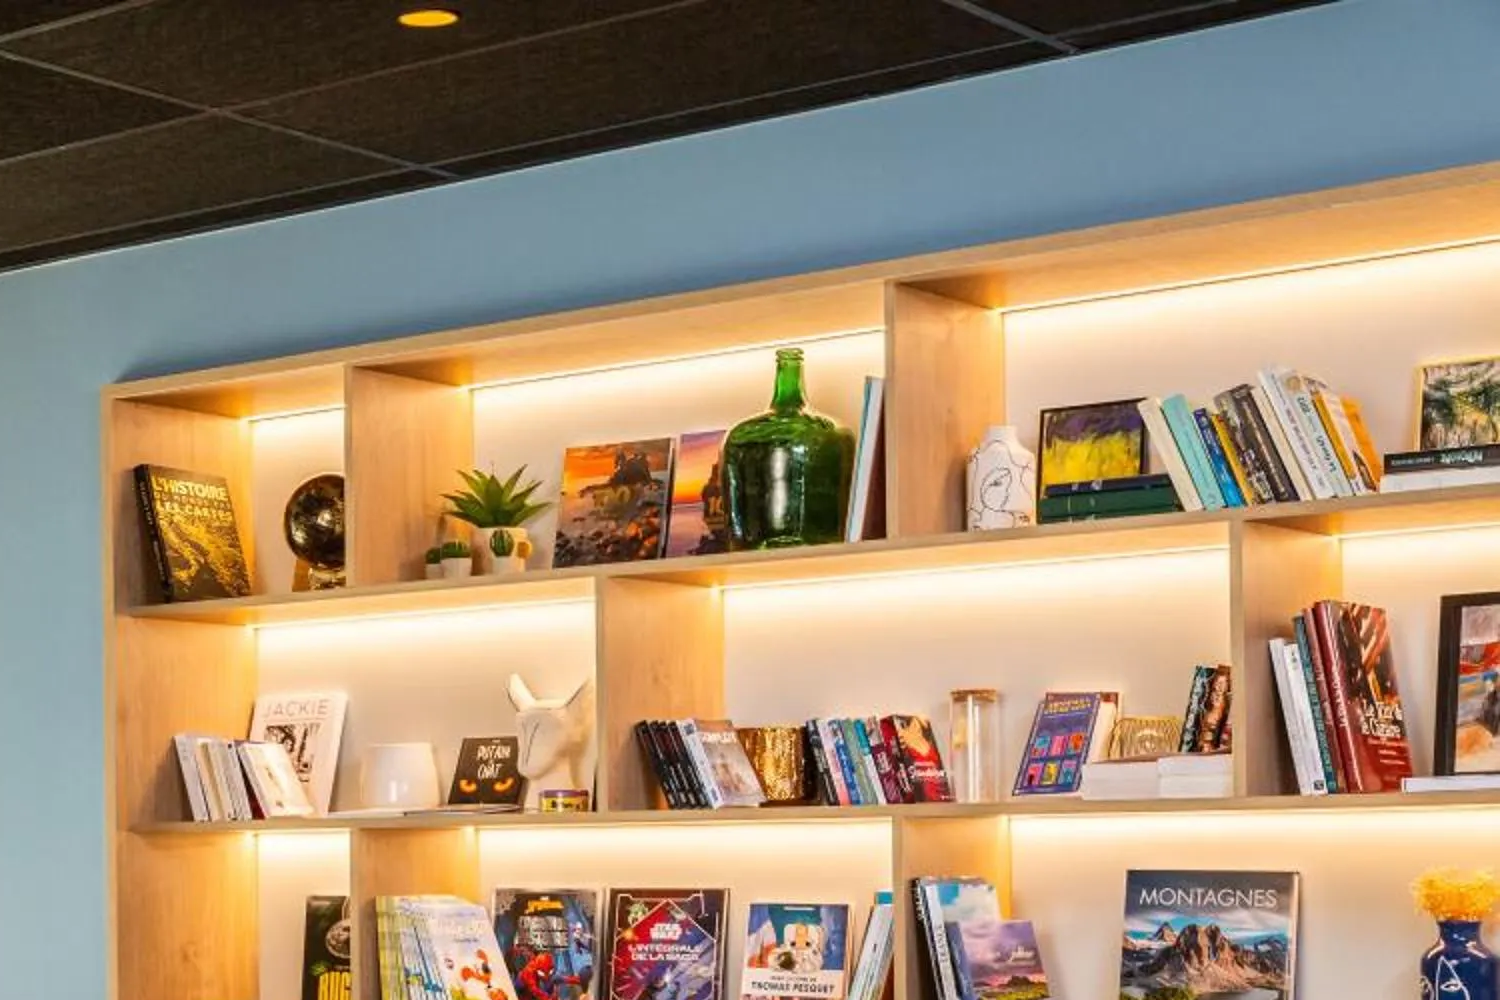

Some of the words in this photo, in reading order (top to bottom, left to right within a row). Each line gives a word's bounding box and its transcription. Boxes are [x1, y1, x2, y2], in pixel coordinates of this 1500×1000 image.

[262, 699, 329, 718] JACKIE
[1139, 887, 1277, 908] MONTAGNES
[793, 983, 835, 993] PESQUET
